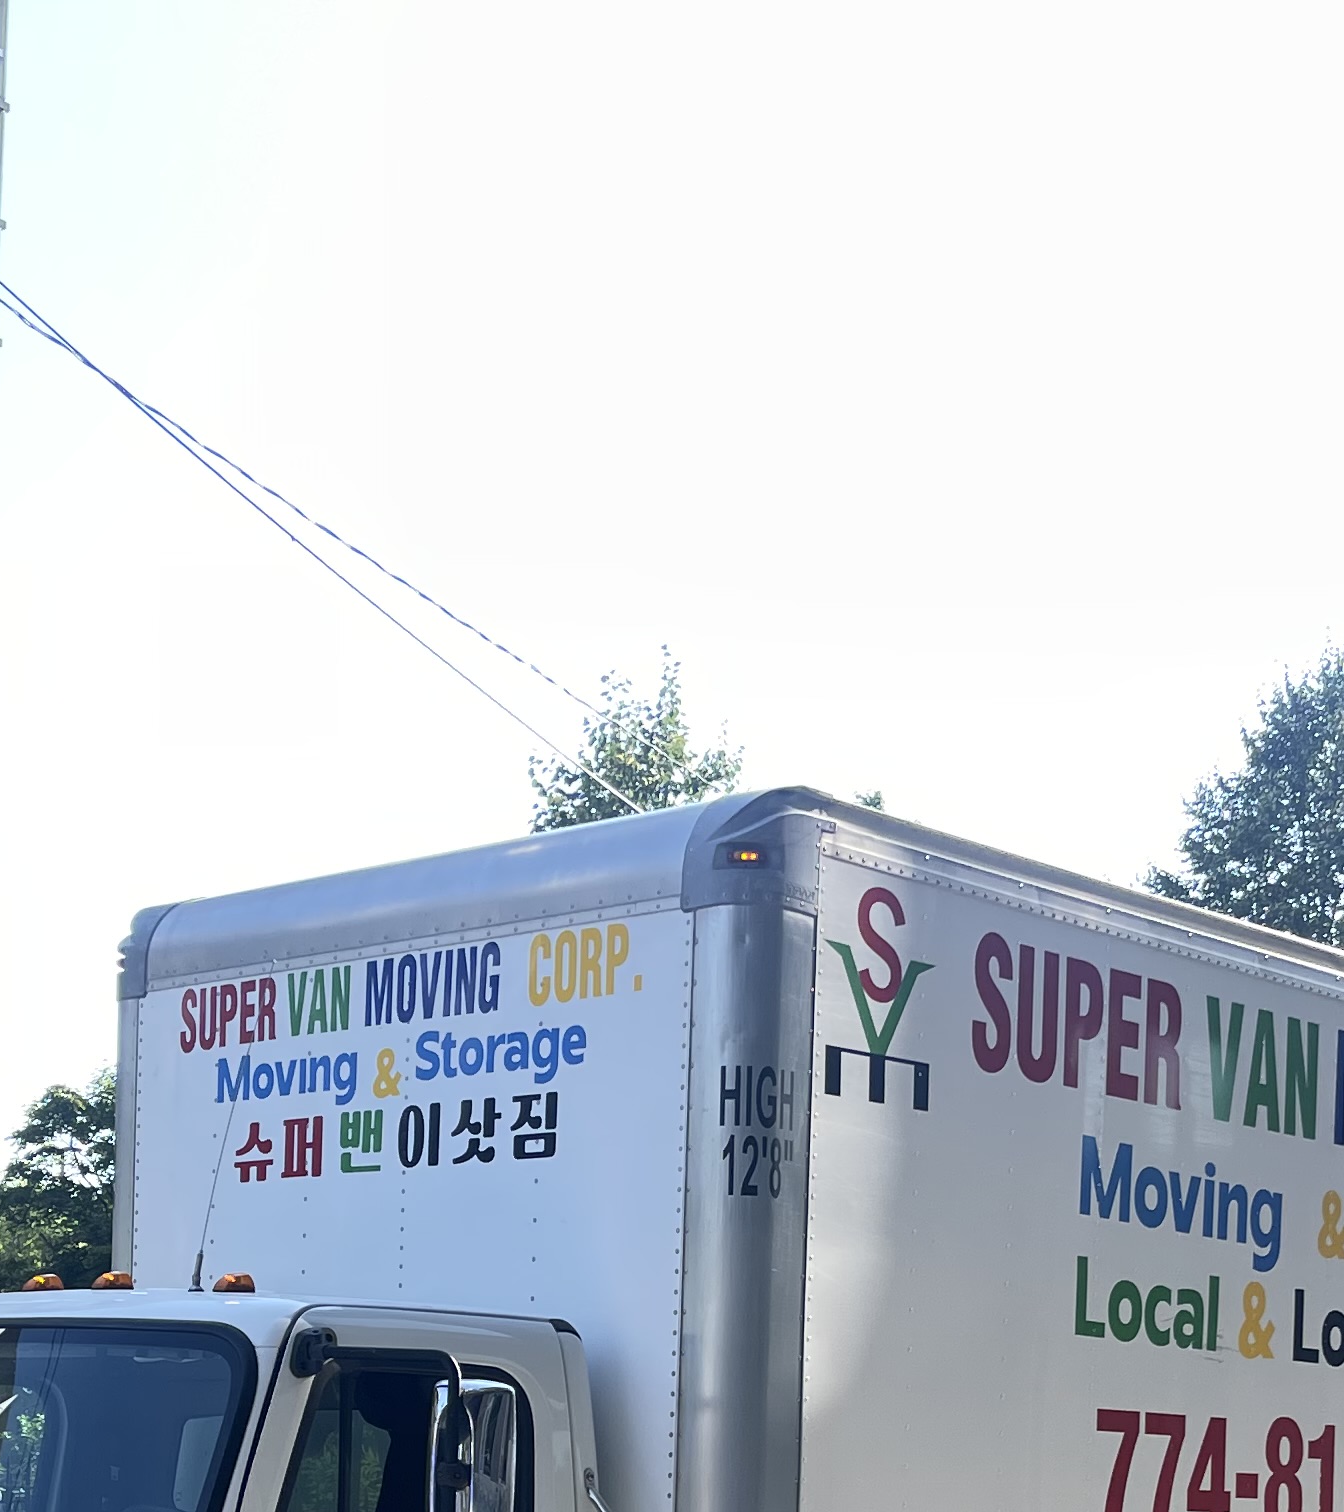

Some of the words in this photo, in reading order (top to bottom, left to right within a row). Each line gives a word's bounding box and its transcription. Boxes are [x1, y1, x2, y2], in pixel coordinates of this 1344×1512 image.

[180, 978, 276, 1053] SUPER
[288, 965, 351, 1036] VAN
[365, 941, 501, 1027] MOVING
[528, 924, 643, 1006] CORP.
[972, 931, 1181, 1111] SUPER
[1206, 995, 1319, 1140] VAN
[216, 1050, 358, 1104] Moving
[373, 1048, 401, 1098] &
[415, 1021, 587, 1084] Storage
[720, 1066, 794, 1131] HIGH
[234, 1116, 323, 1183] 슈퍼
[340, 1110, 381, 1173] 밴
[398, 1093, 558, 1169] 이삿짐
[722, 1134, 793, 1199] 12'8"
[1079, 1135, 1283, 1272] Moving
[1075, 1255, 1219, 1352] Local
[1238, 1280, 1275, 1359] &
